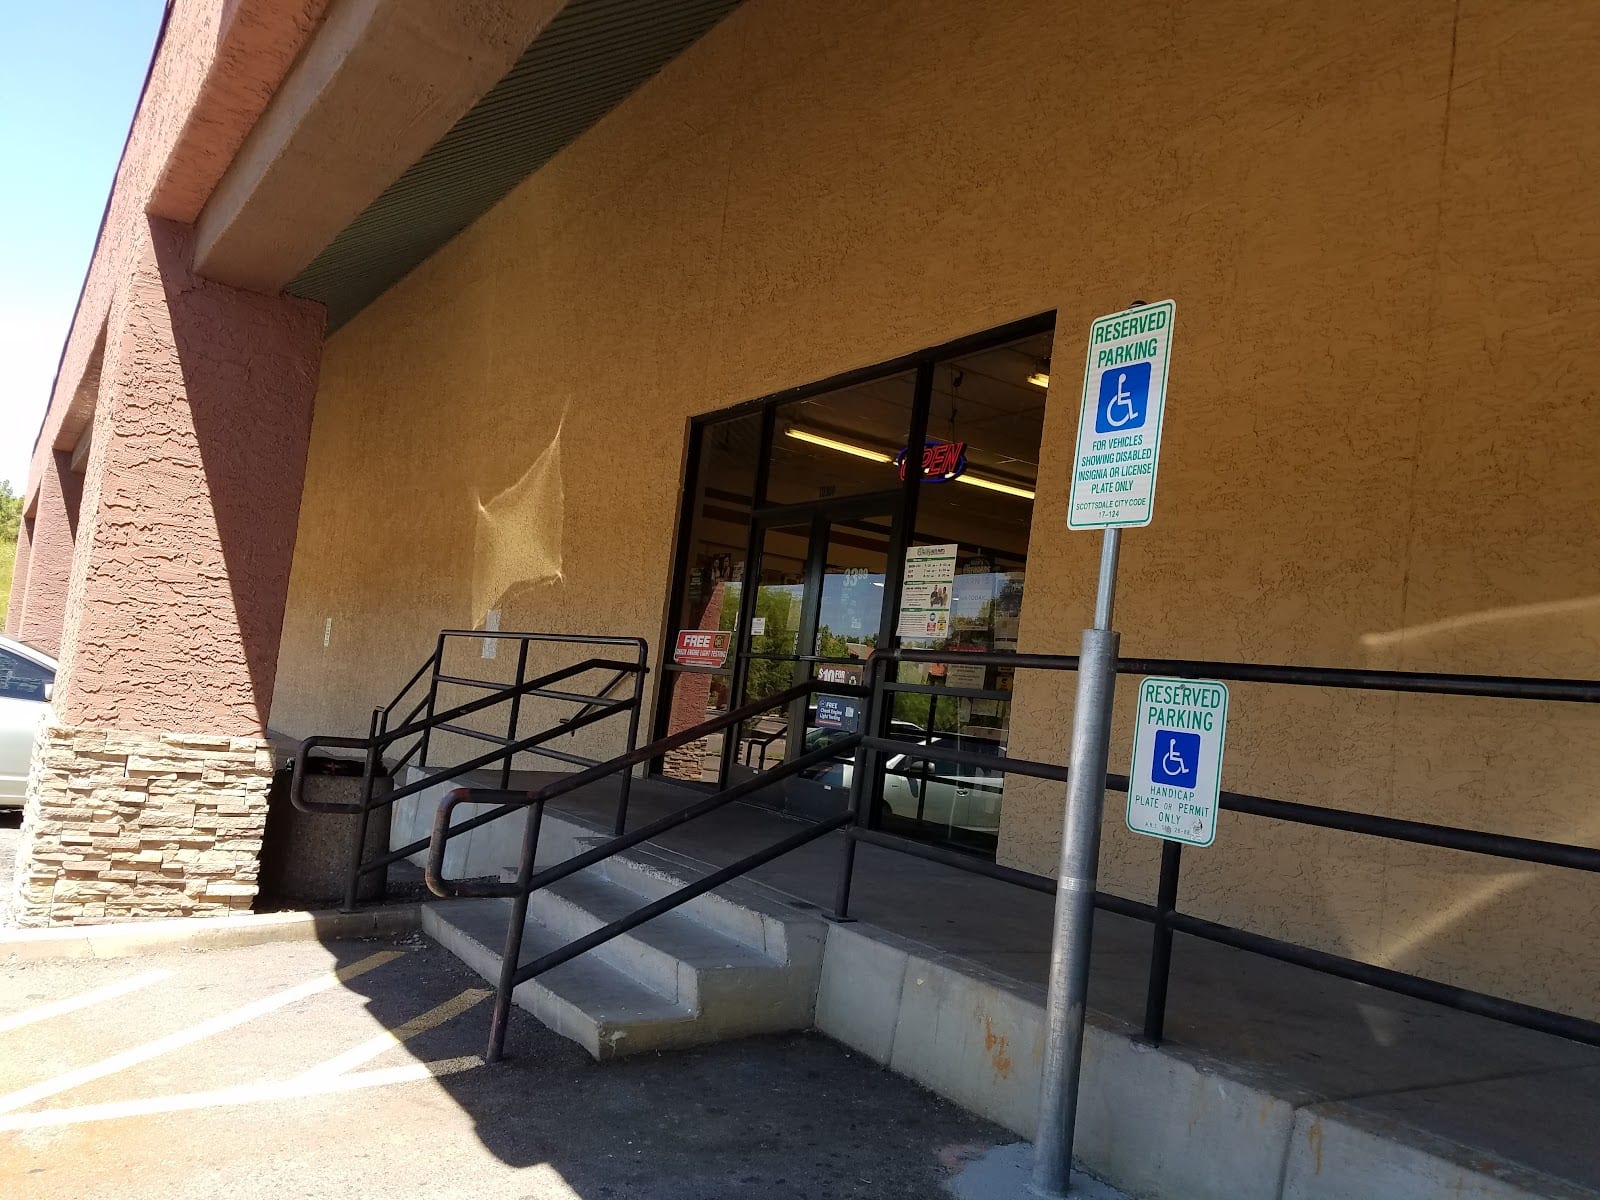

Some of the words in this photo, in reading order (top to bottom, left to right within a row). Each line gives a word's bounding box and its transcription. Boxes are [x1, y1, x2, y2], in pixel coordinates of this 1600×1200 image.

[1095, 310, 1167, 344] RESERVED
[1097, 338, 1158, 368] PARKING
[1092, 440, 1107, 451] FOR
[1108, 434, 1143, 449] VEHICLES
[1081, 453, 1115, 467] SHOWING
[1115, 448, 1152, 462] DISABLED
[1078, 468, 1108, 481] INSIGNIA
[1109, 466, 1120, 478] OR
[1121, 463, 1152, 476] LICENSE
[1091, 482, 1113, 494] PLATE
[1114, 480, 1134, 491] ONLY
[1076, 500, 1113, 510] SCOTTSDALE
[1114, 499, 1129, 508] CITY
[1128, 497, 1147, 506] CODE
[1098, 510, 1120, 518] 17-124
[683, 635, 712, 648] FREE
[835, 669, 846, 679] FOR
[1145, 684, 1221, 709] RESERVED
[1147, 706, 1214, 732] PARKING
[1150, 785, 1195, 801] HANDICAP
[1135, 794, 1159, 808] PLATE
[1163, 802, 1173, 811] OR
[1178, 802, 1209, 818] PERMIT
[1158, 811, 1182, 825] ONLY
